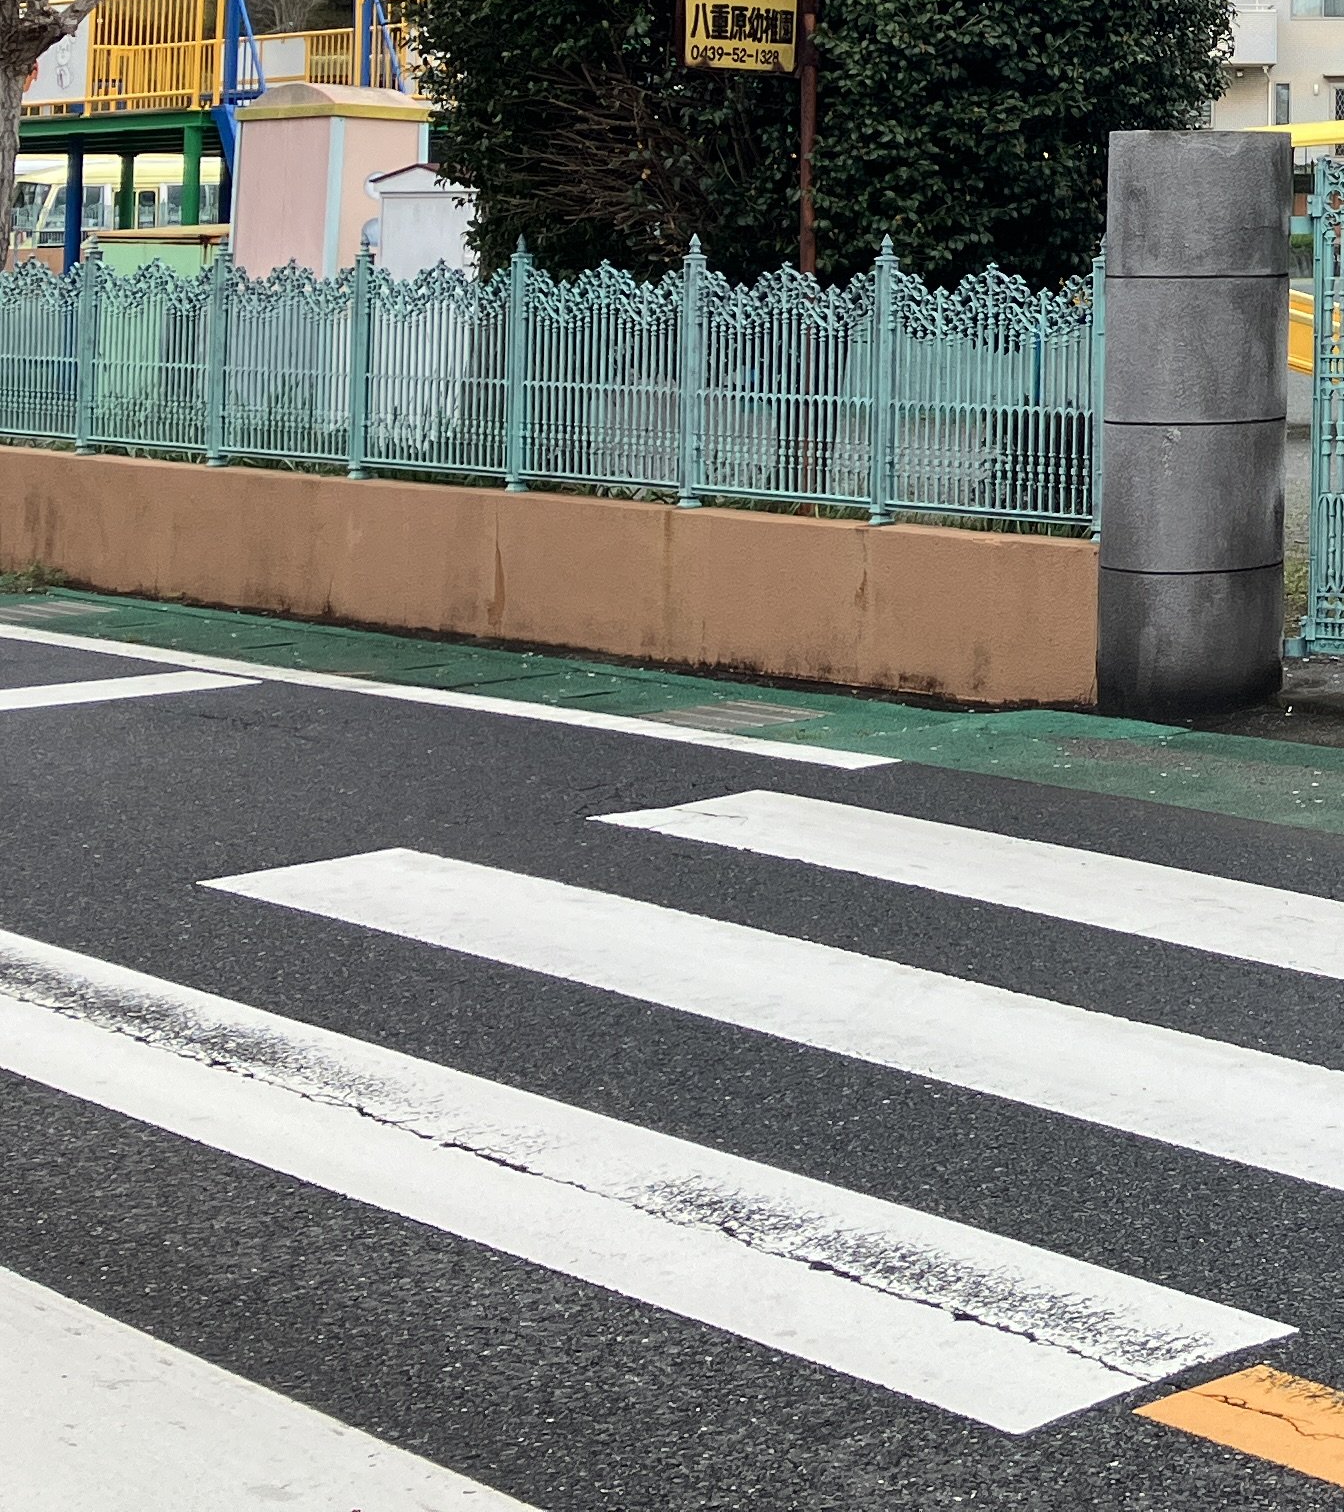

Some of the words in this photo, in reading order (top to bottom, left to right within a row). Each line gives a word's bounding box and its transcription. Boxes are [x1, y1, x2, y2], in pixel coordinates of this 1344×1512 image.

[690, 2, 795, 45] 八重原幼稚園
[690, 44, 780, 65] 0439-52-1328
